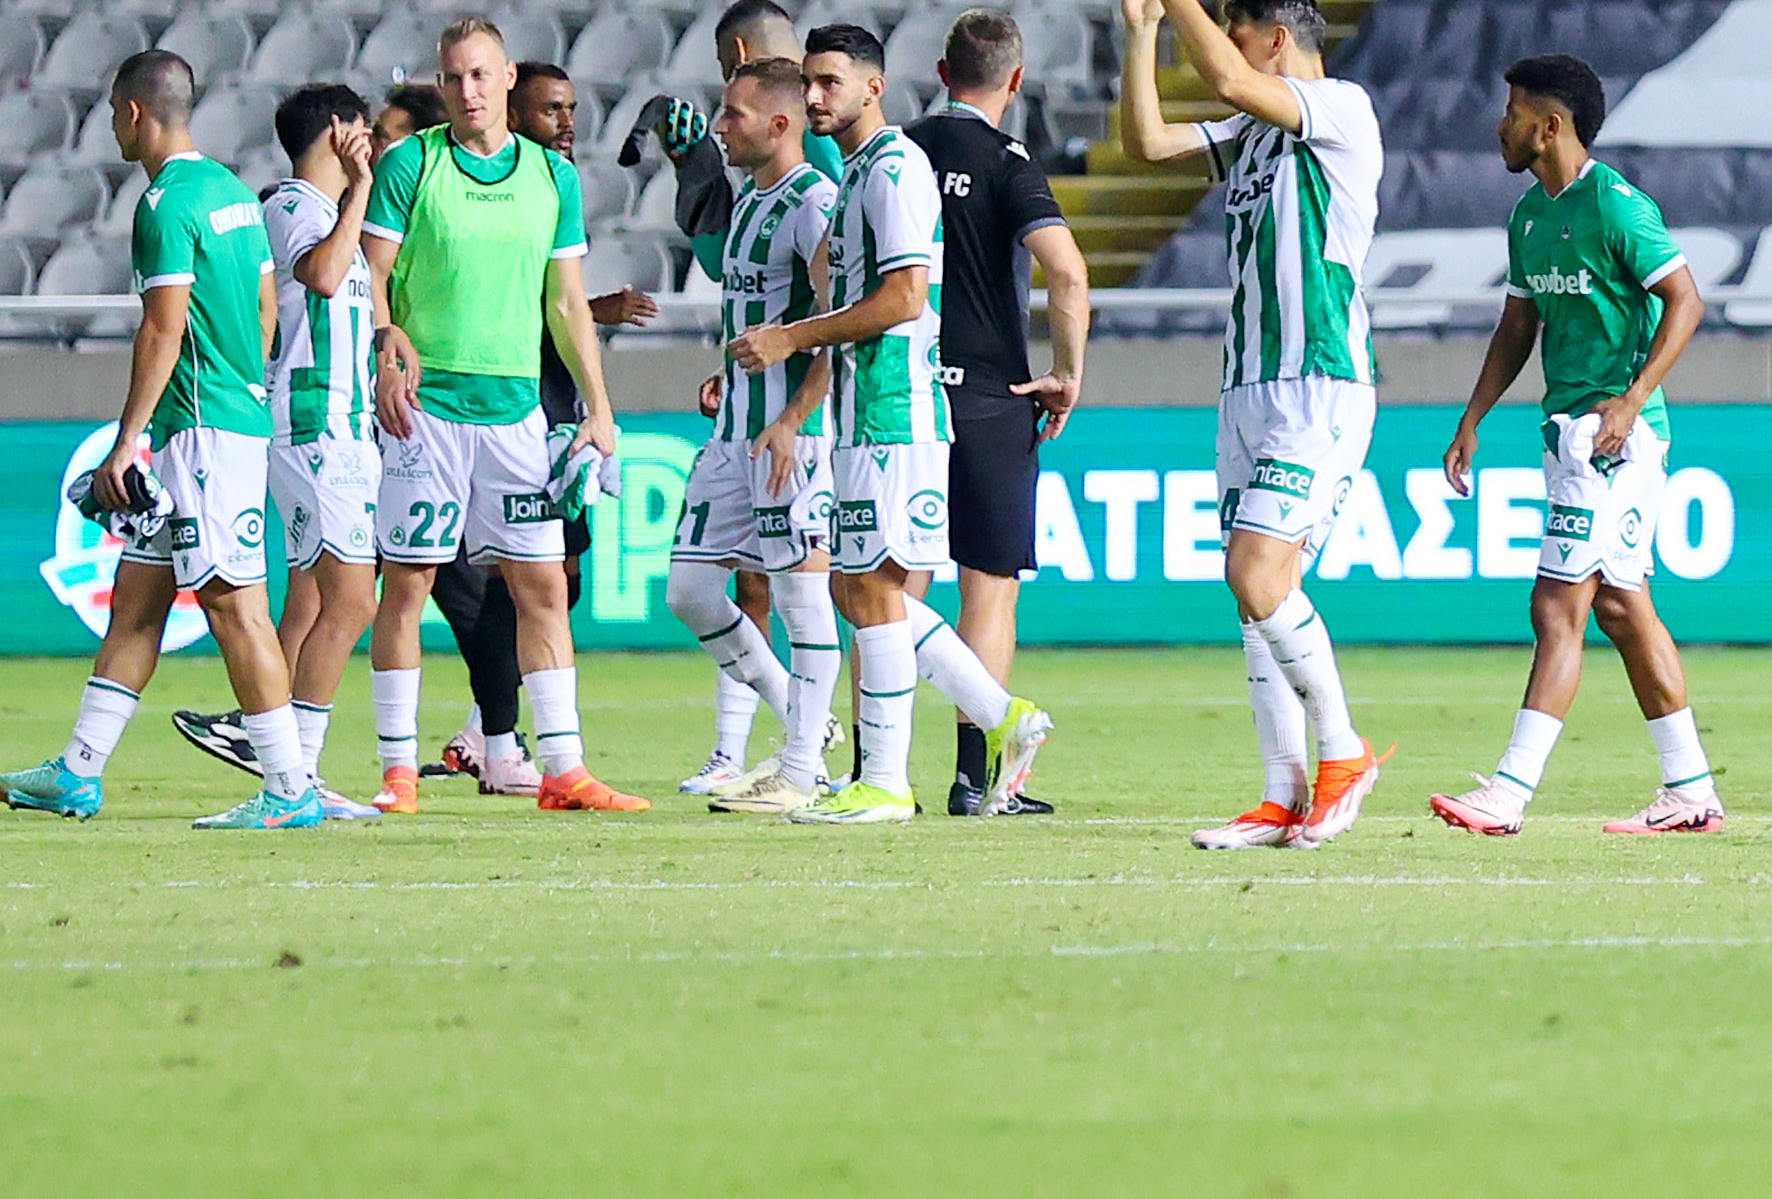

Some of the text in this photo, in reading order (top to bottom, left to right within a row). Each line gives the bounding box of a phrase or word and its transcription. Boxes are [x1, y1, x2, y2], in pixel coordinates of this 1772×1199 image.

[466, 191, 514, 202] macron
[944, 172, 971, 197] FC
[1253, 465, 1310, 493] ntace
[508, 497, 549, 521] Join
[408, 501, 461, 548] 22
